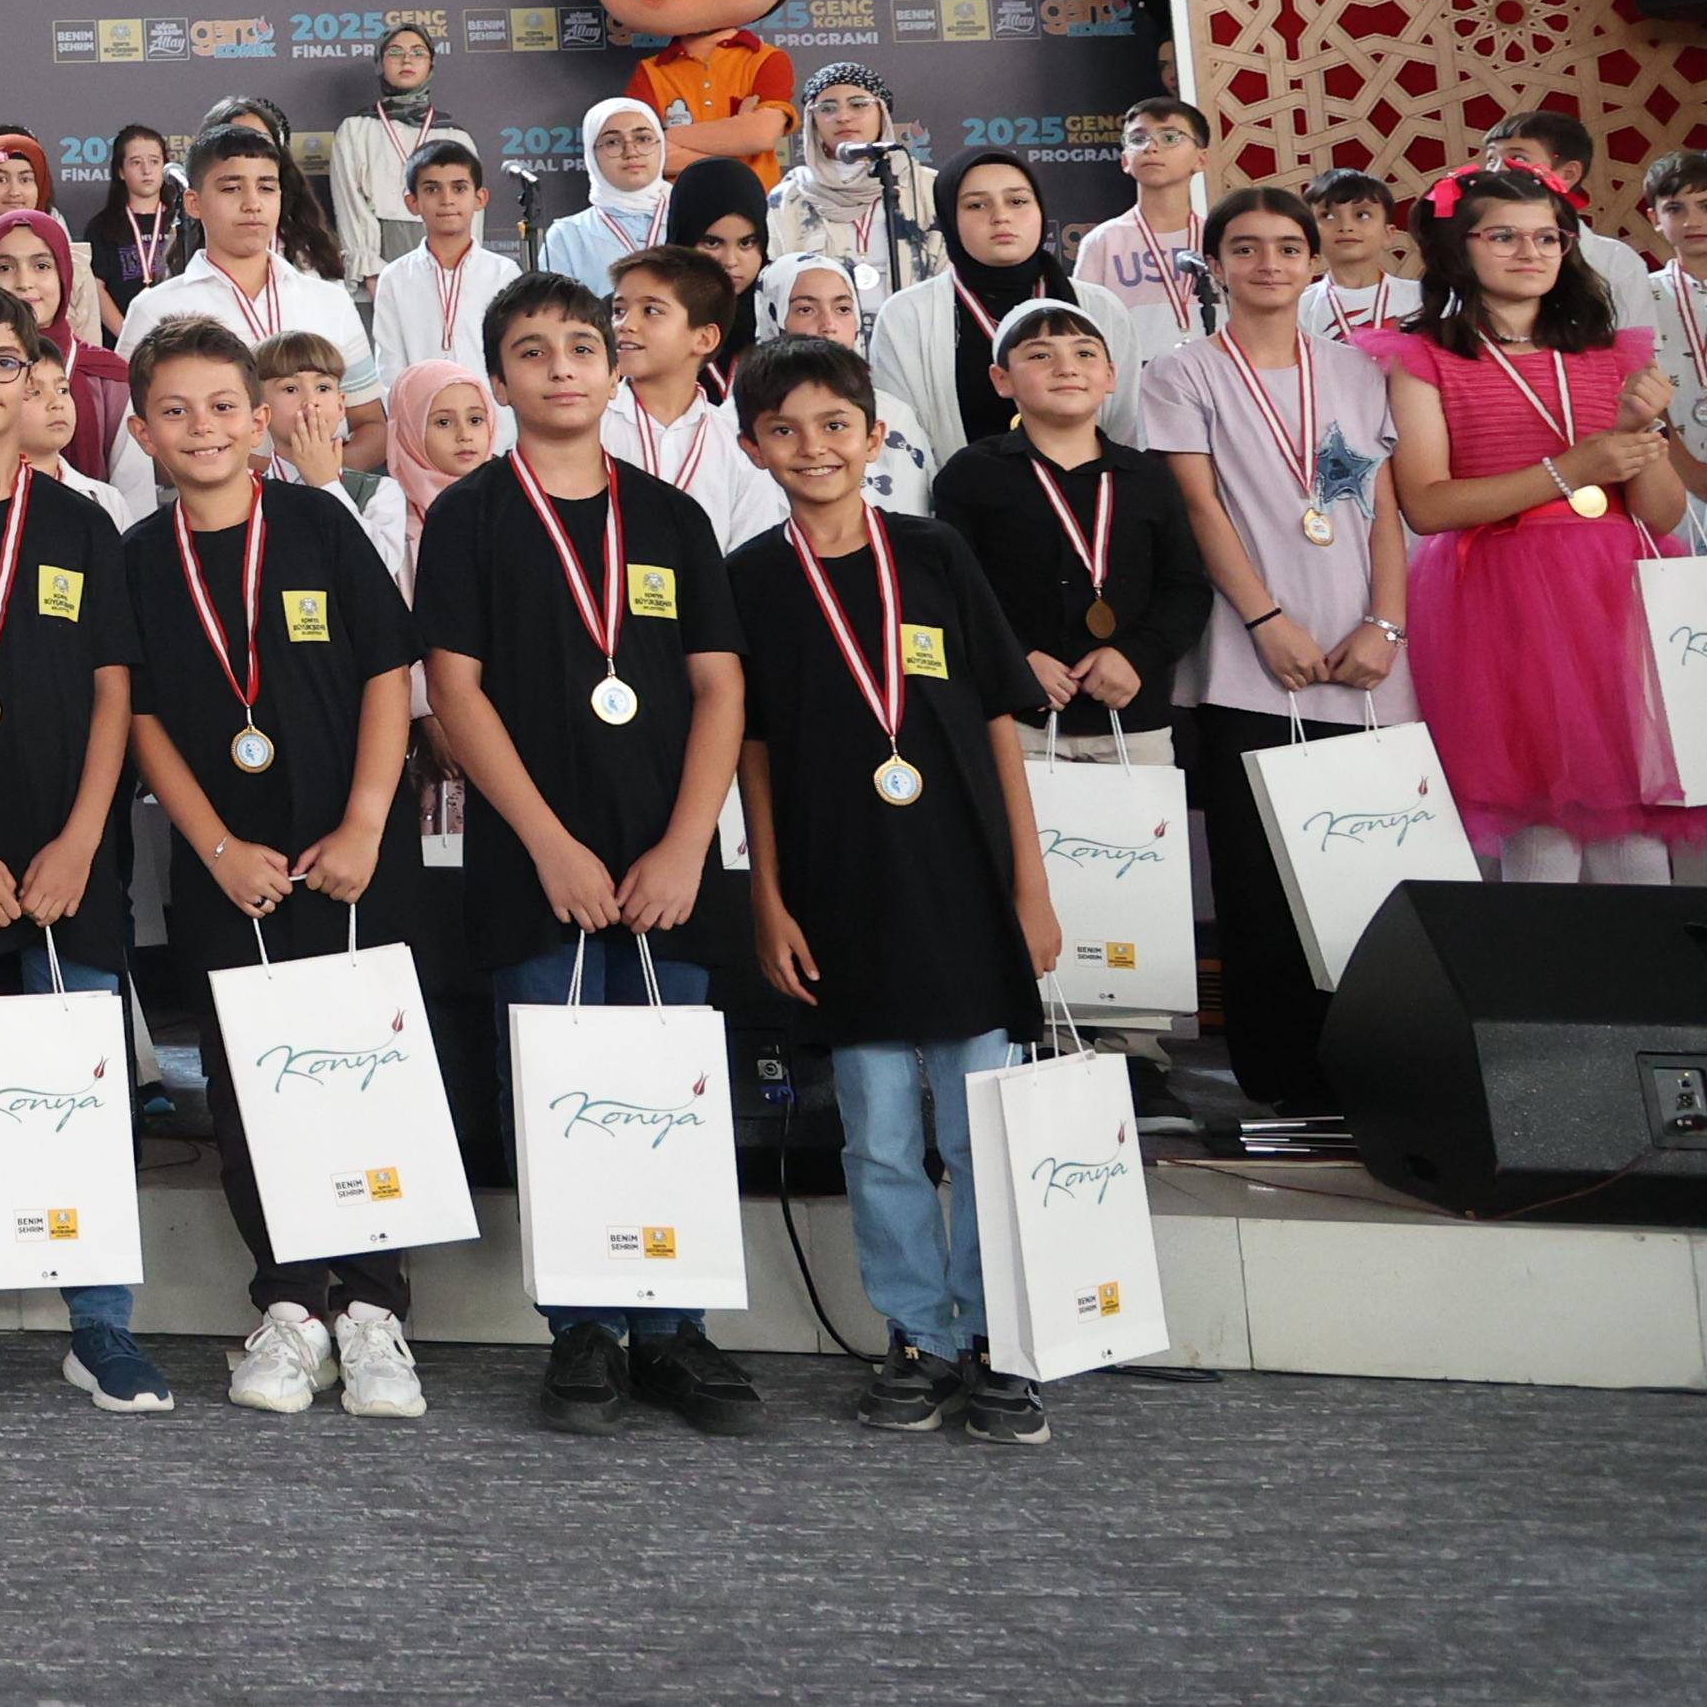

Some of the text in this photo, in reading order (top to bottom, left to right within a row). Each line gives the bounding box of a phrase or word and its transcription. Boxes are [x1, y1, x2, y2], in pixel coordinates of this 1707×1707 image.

[290, 11, 385, 41] 2025
[816, 15, 875, 27] KOMEK
[775, 32, 878, 46] PROGRAMI
[963, 116, 1064, 145] 2025
[1028, 147, 1125, 163] PROGRAM
[1300, 812, 1433, 852] Konya
[1039, 830, 1166, 878] Konya
[256, 1046, 409, 1093] Konya
[547, 1093, 703, 1148] Konya
[1031, 1158, 1128, 1207] Konya
